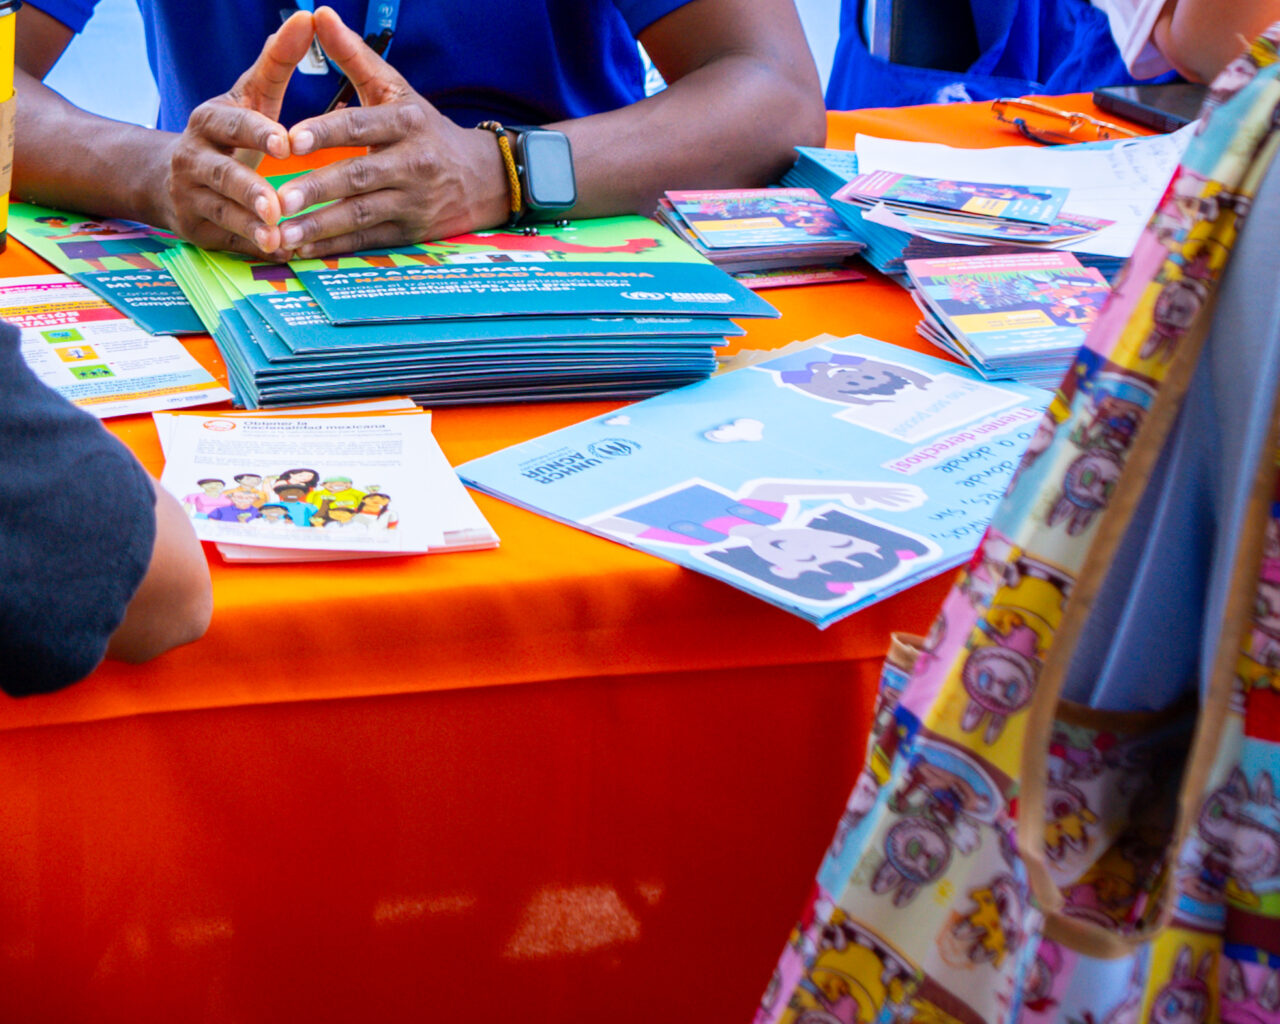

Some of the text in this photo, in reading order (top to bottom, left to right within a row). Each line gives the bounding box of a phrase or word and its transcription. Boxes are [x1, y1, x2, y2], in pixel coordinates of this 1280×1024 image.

[317, 272, 380, 280] PASO
[354, 272, 530, 284] NACIONALIDAD
[326, 284, 384, 292] Conoce
[329, 287, 406, 296] personas
[332, 289, 472, 300] complementaria
[890, 430, 977, 474] derechos!
[521, 452, 586, 478] ACNUR
[535, 457, 602, 484] UNHCR
